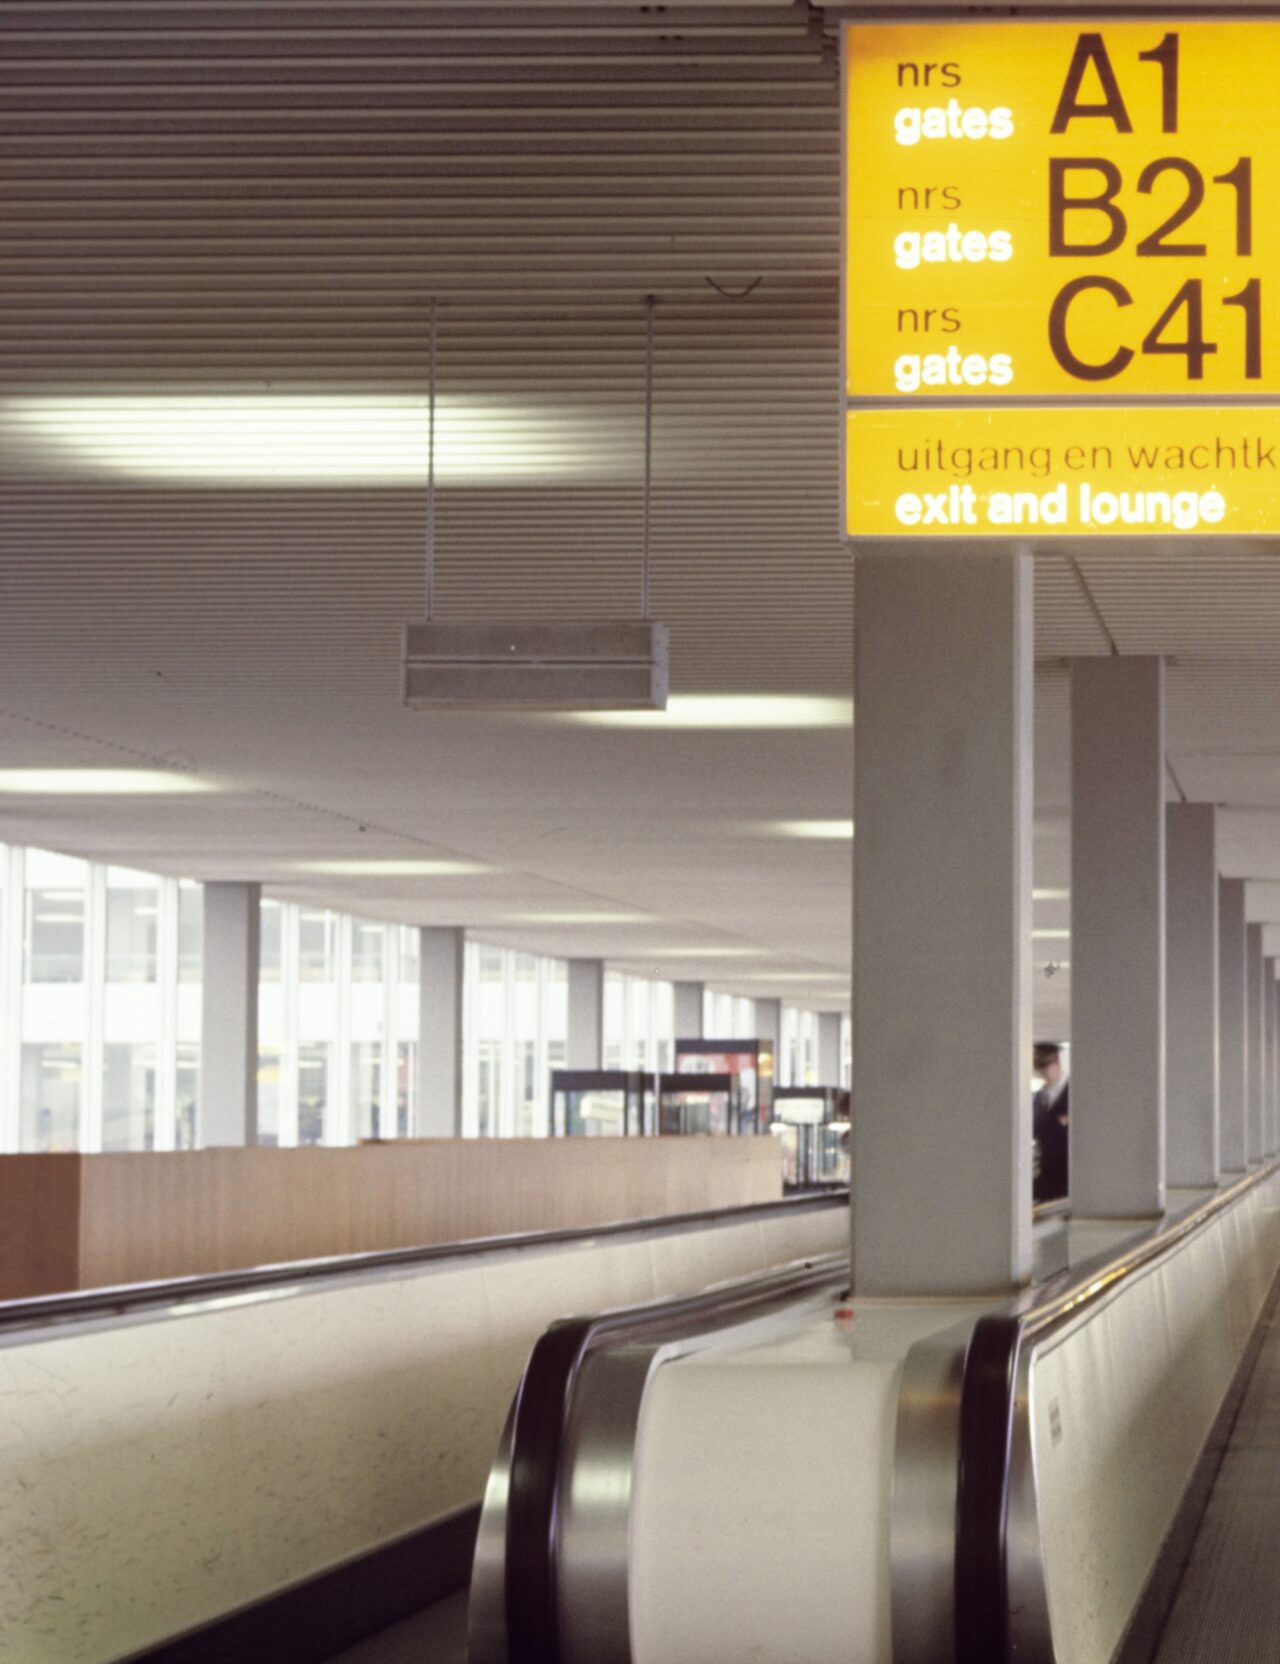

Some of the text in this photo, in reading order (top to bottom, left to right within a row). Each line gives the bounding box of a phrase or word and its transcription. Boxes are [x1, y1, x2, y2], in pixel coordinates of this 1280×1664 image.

[896, 62, 963, 88] nrs
[1050, 32, 1181, 134] A1
[893, 98, 1014, 146] gates
[896, 186, 963, 210] nrs
[1048, 156, 1253, 258] B21
[893, 222, 1014, 270] gates
[896, 308, 963, 333] nrs
[1047, 275, 1263, 382] C41
[893, 345, 1014, 393] gates
[897, 438, 1053, 478] uitgang
[1063, 447, 1114, 470] en
[894, 482, 1227, 530] exit and lounge
